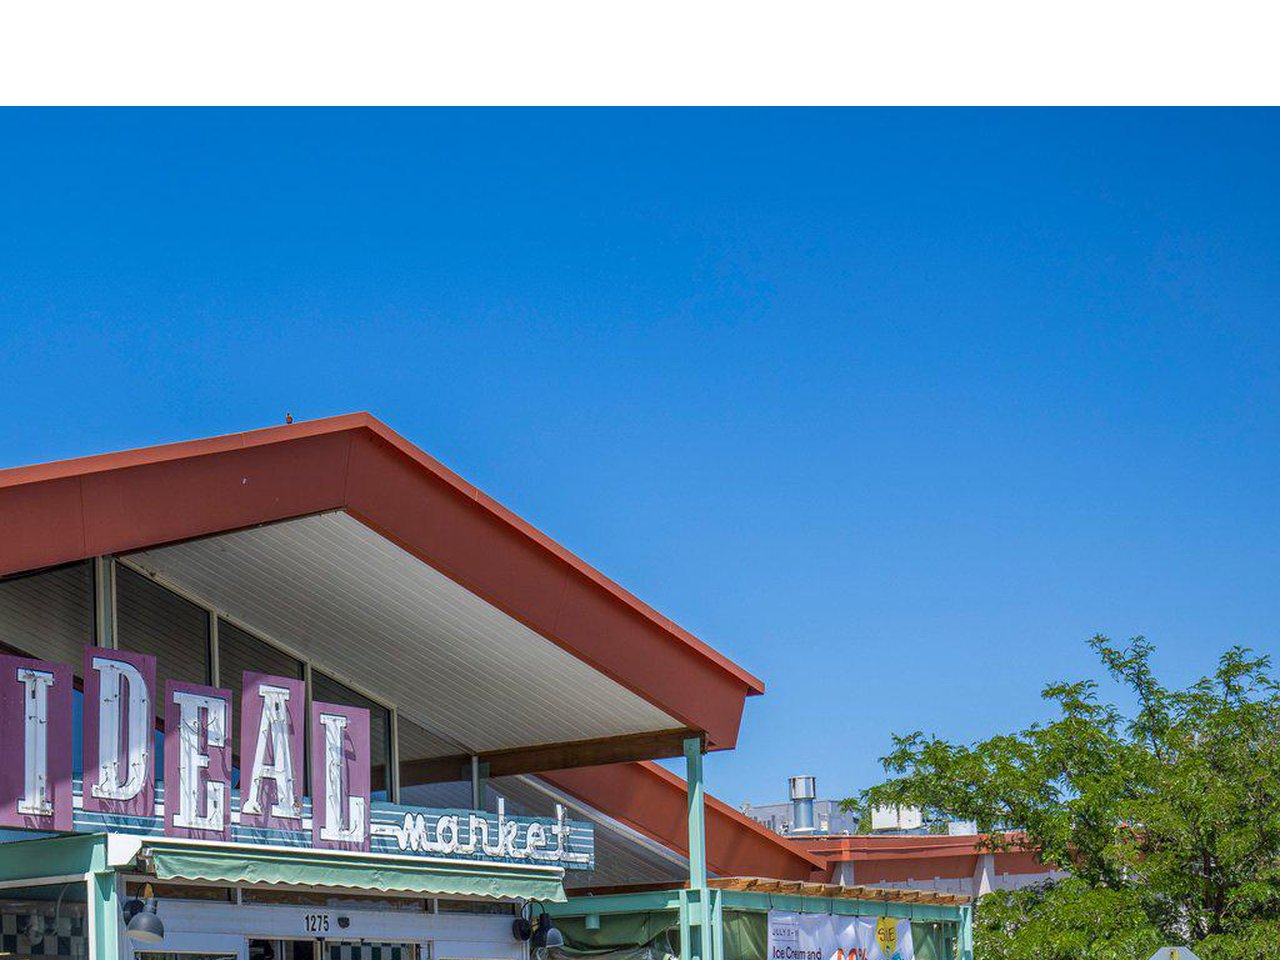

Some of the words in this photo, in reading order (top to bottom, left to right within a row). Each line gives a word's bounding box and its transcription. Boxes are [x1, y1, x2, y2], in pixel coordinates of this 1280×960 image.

[16, 656, 366, 844] IDEAL
[396, 797, 594, 863] market
[305, 914, 329, 932] 1275
